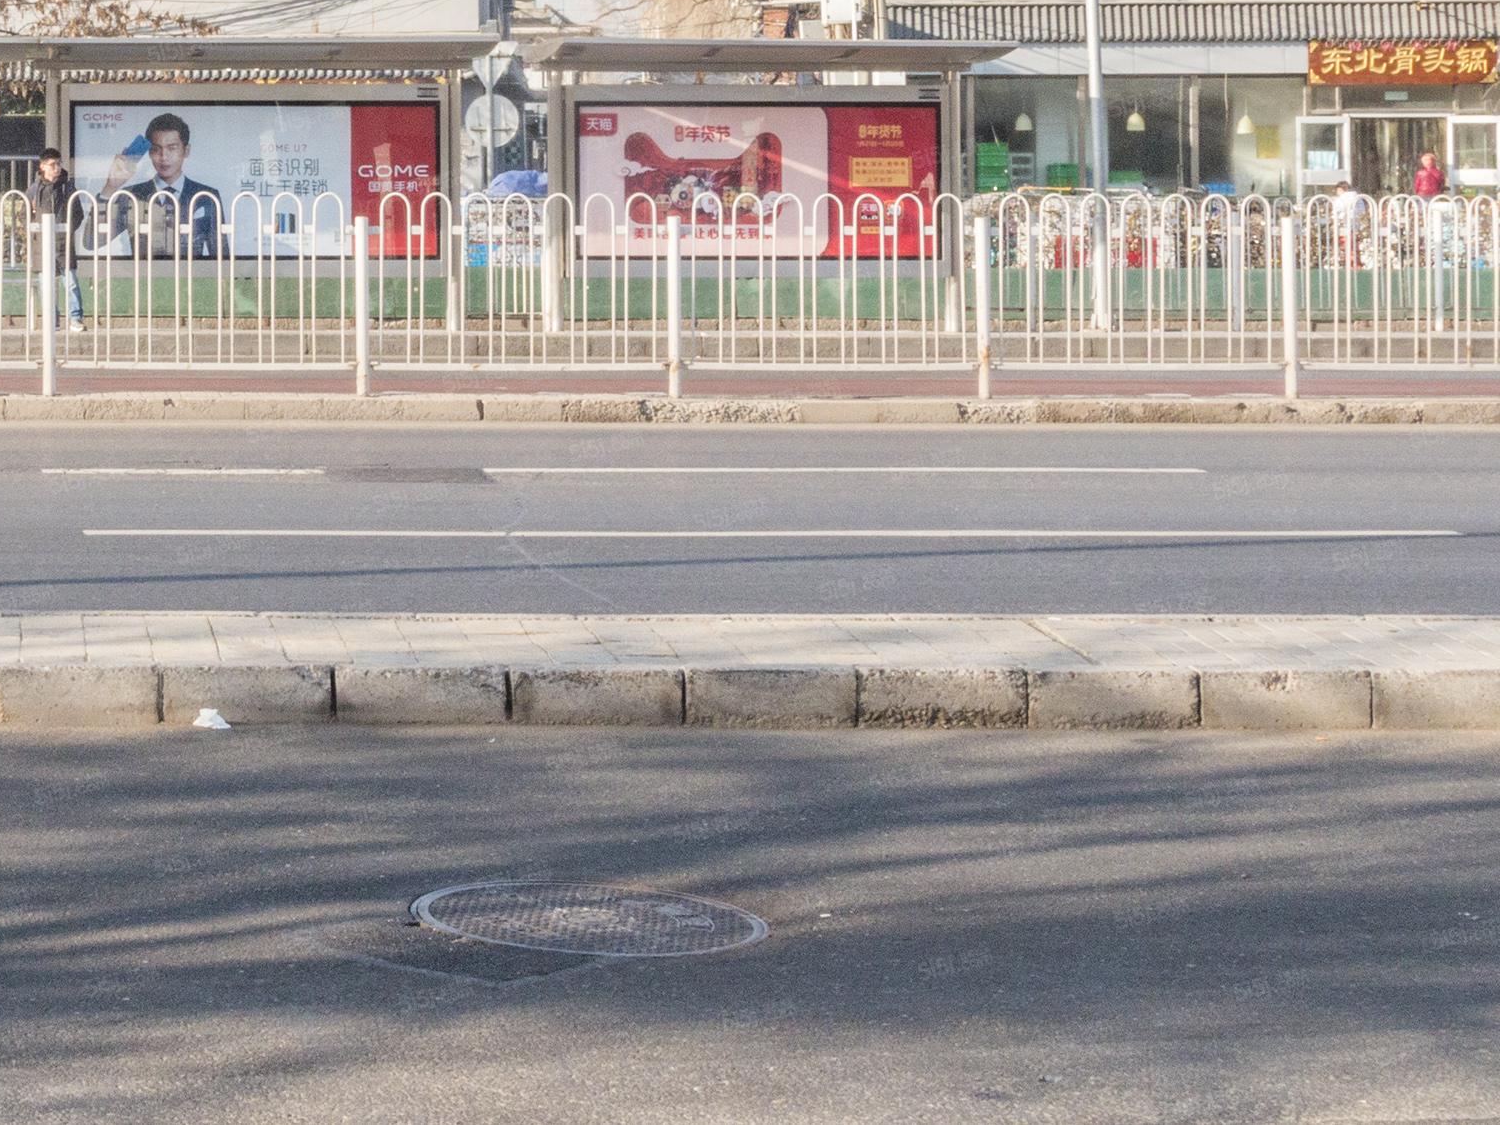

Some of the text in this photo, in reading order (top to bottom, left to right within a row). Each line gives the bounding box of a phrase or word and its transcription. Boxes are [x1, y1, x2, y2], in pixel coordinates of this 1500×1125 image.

[1320, 46, 1488, 76] 东北骨头锅
[82, 113, 124, 122] GOME
[586, 117, 613, 131] 天猫
[684, 125, 731, 143] 年货节
[248, 157, 320, 177] 面容识别
[358, 164, 429, 178] GOME
[368, 180, 419, 193] 国美手机
